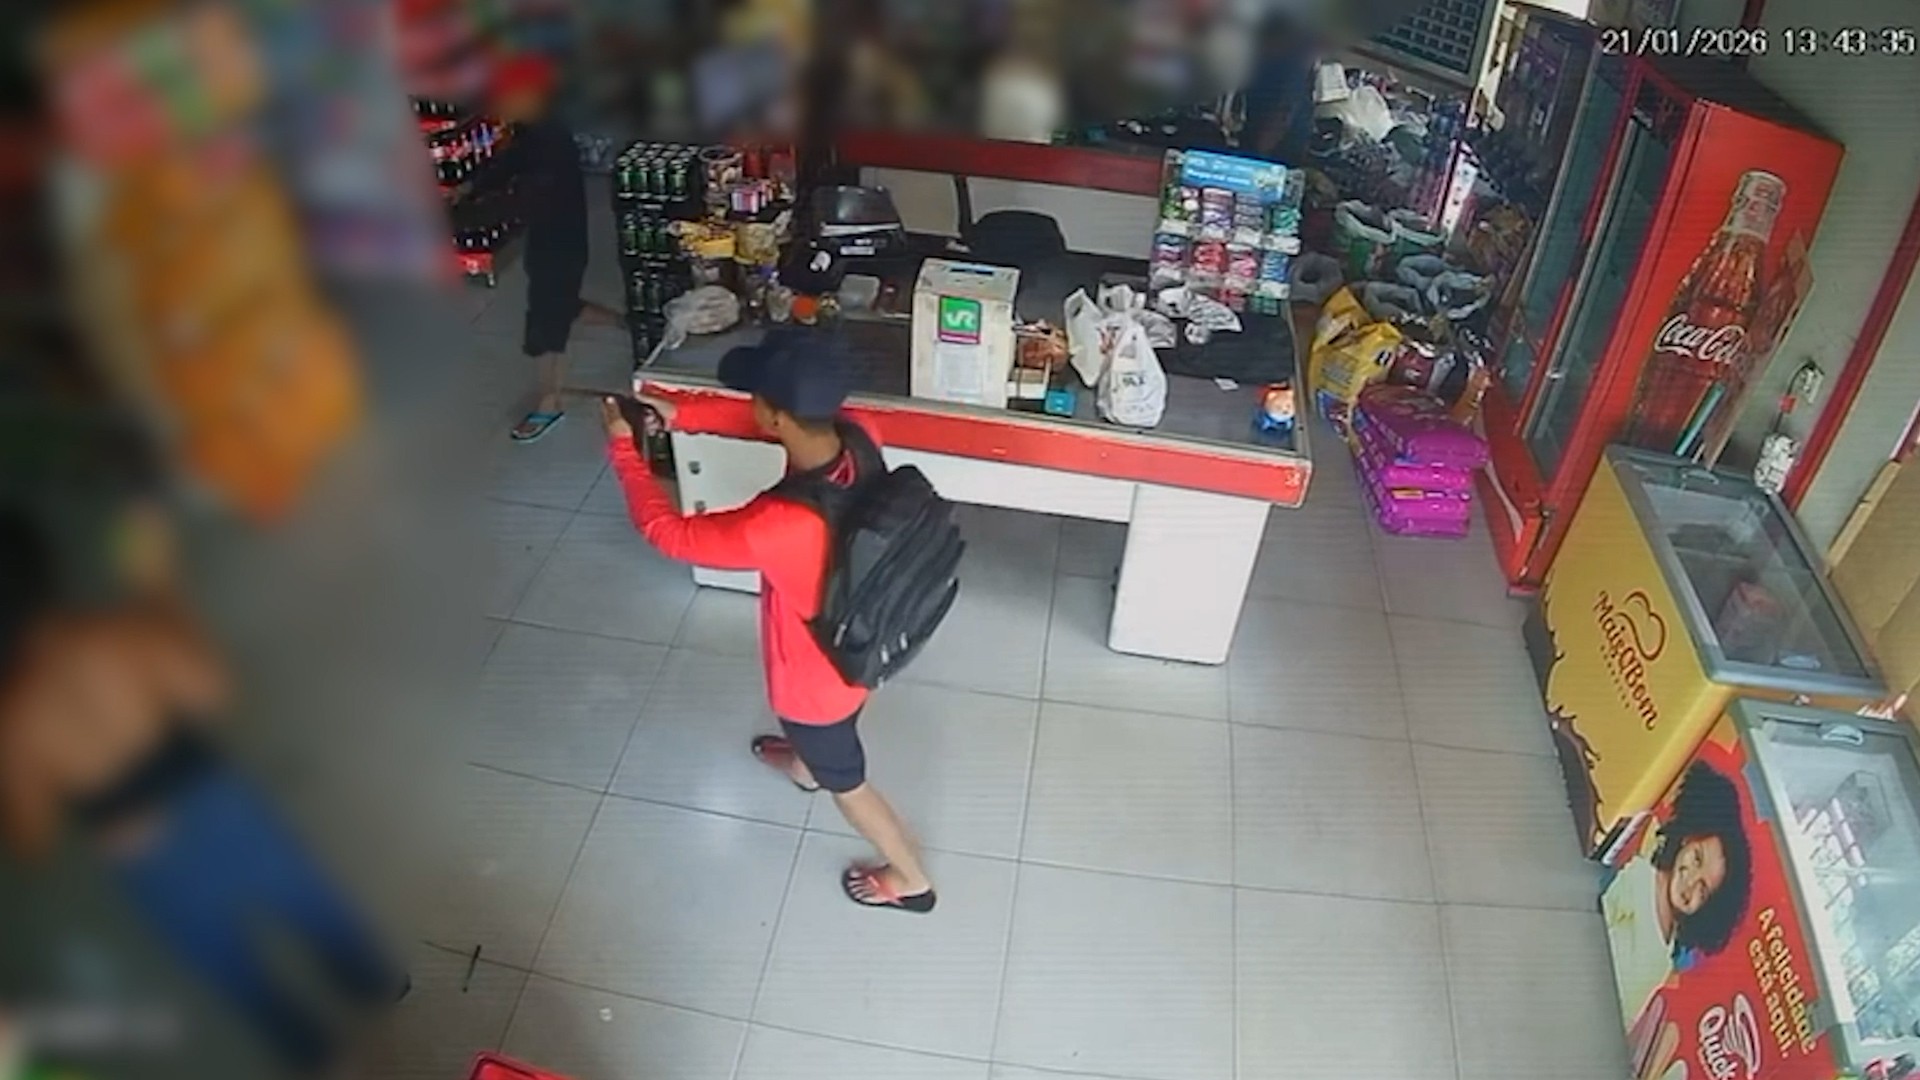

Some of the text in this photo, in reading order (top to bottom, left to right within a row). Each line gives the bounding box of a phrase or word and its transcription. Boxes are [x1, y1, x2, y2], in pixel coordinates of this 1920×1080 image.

[1758, 907, 1775, 933] A
[1749, 938, 1797, 1059] está aqui.
